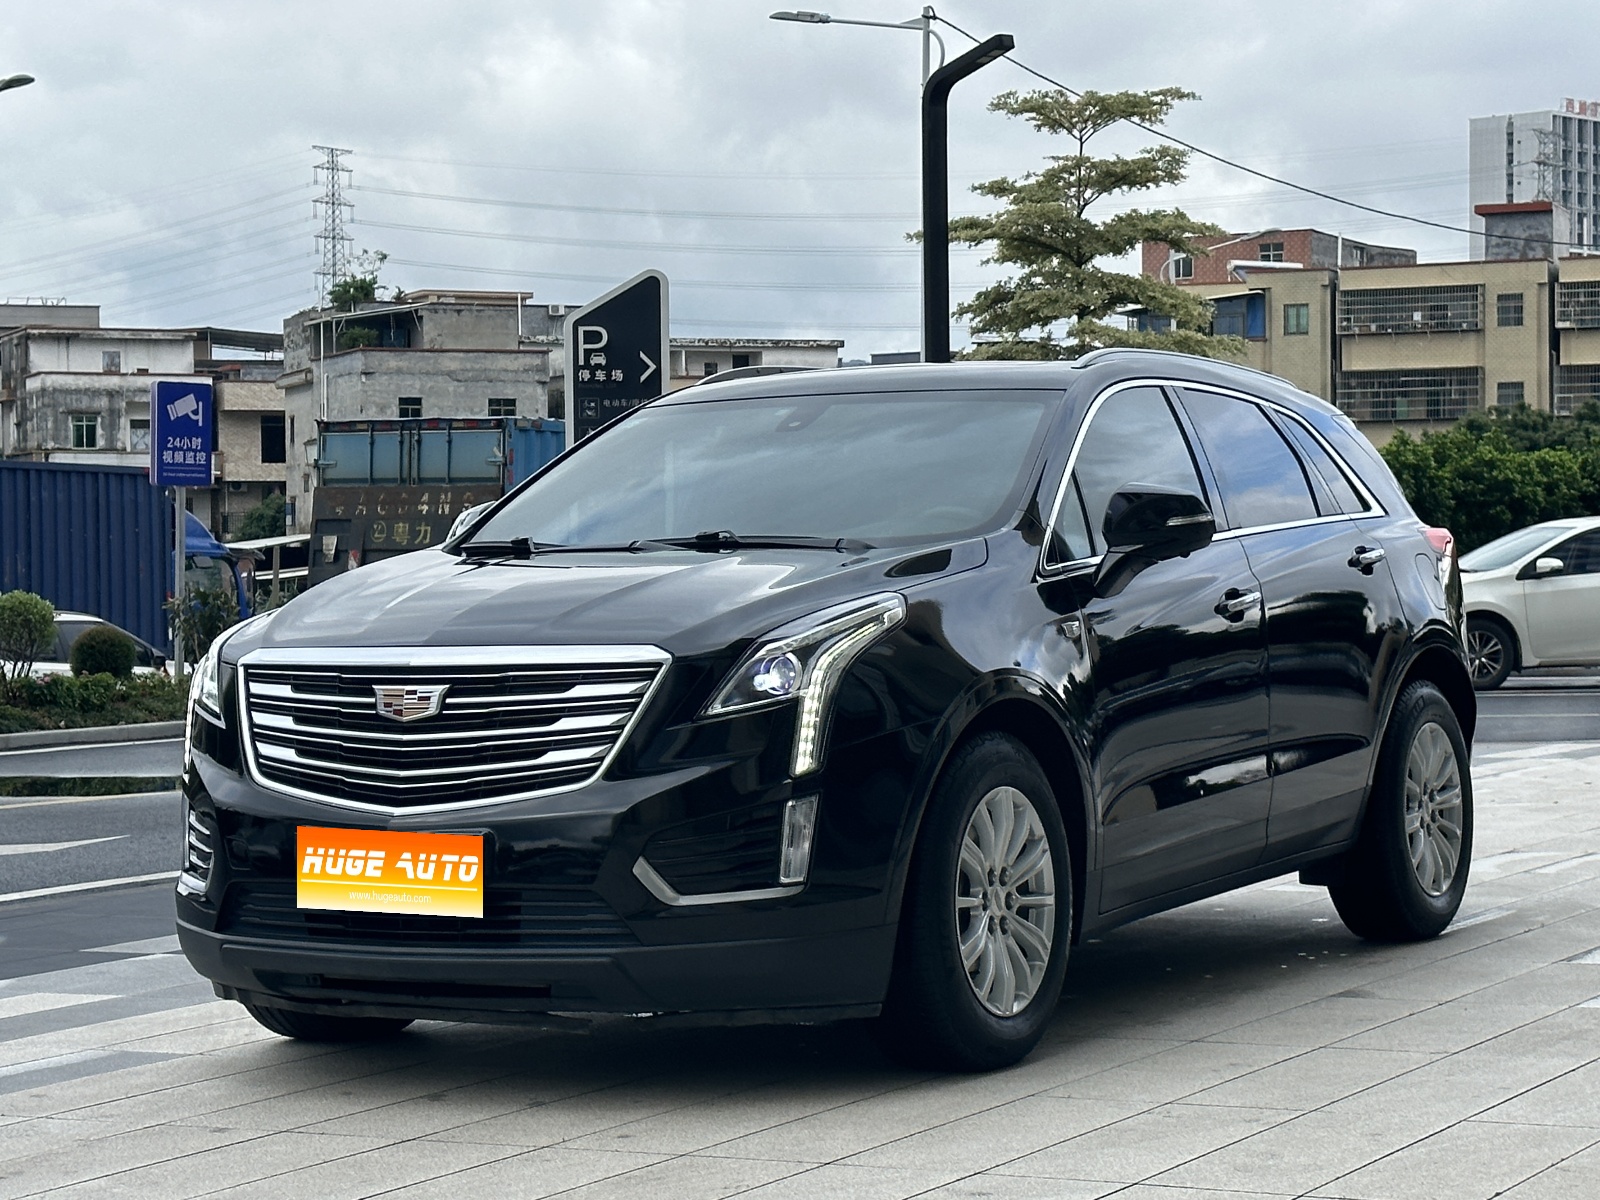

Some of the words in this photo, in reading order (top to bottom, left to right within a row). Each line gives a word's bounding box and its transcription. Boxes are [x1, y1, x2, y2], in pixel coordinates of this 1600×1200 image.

[578, 326, 608, 366] P
[578, 369, 624, 382] 停车场
[167, 437, 202, 450] 24小时
[162, 451, 206, 464] 视频监控
